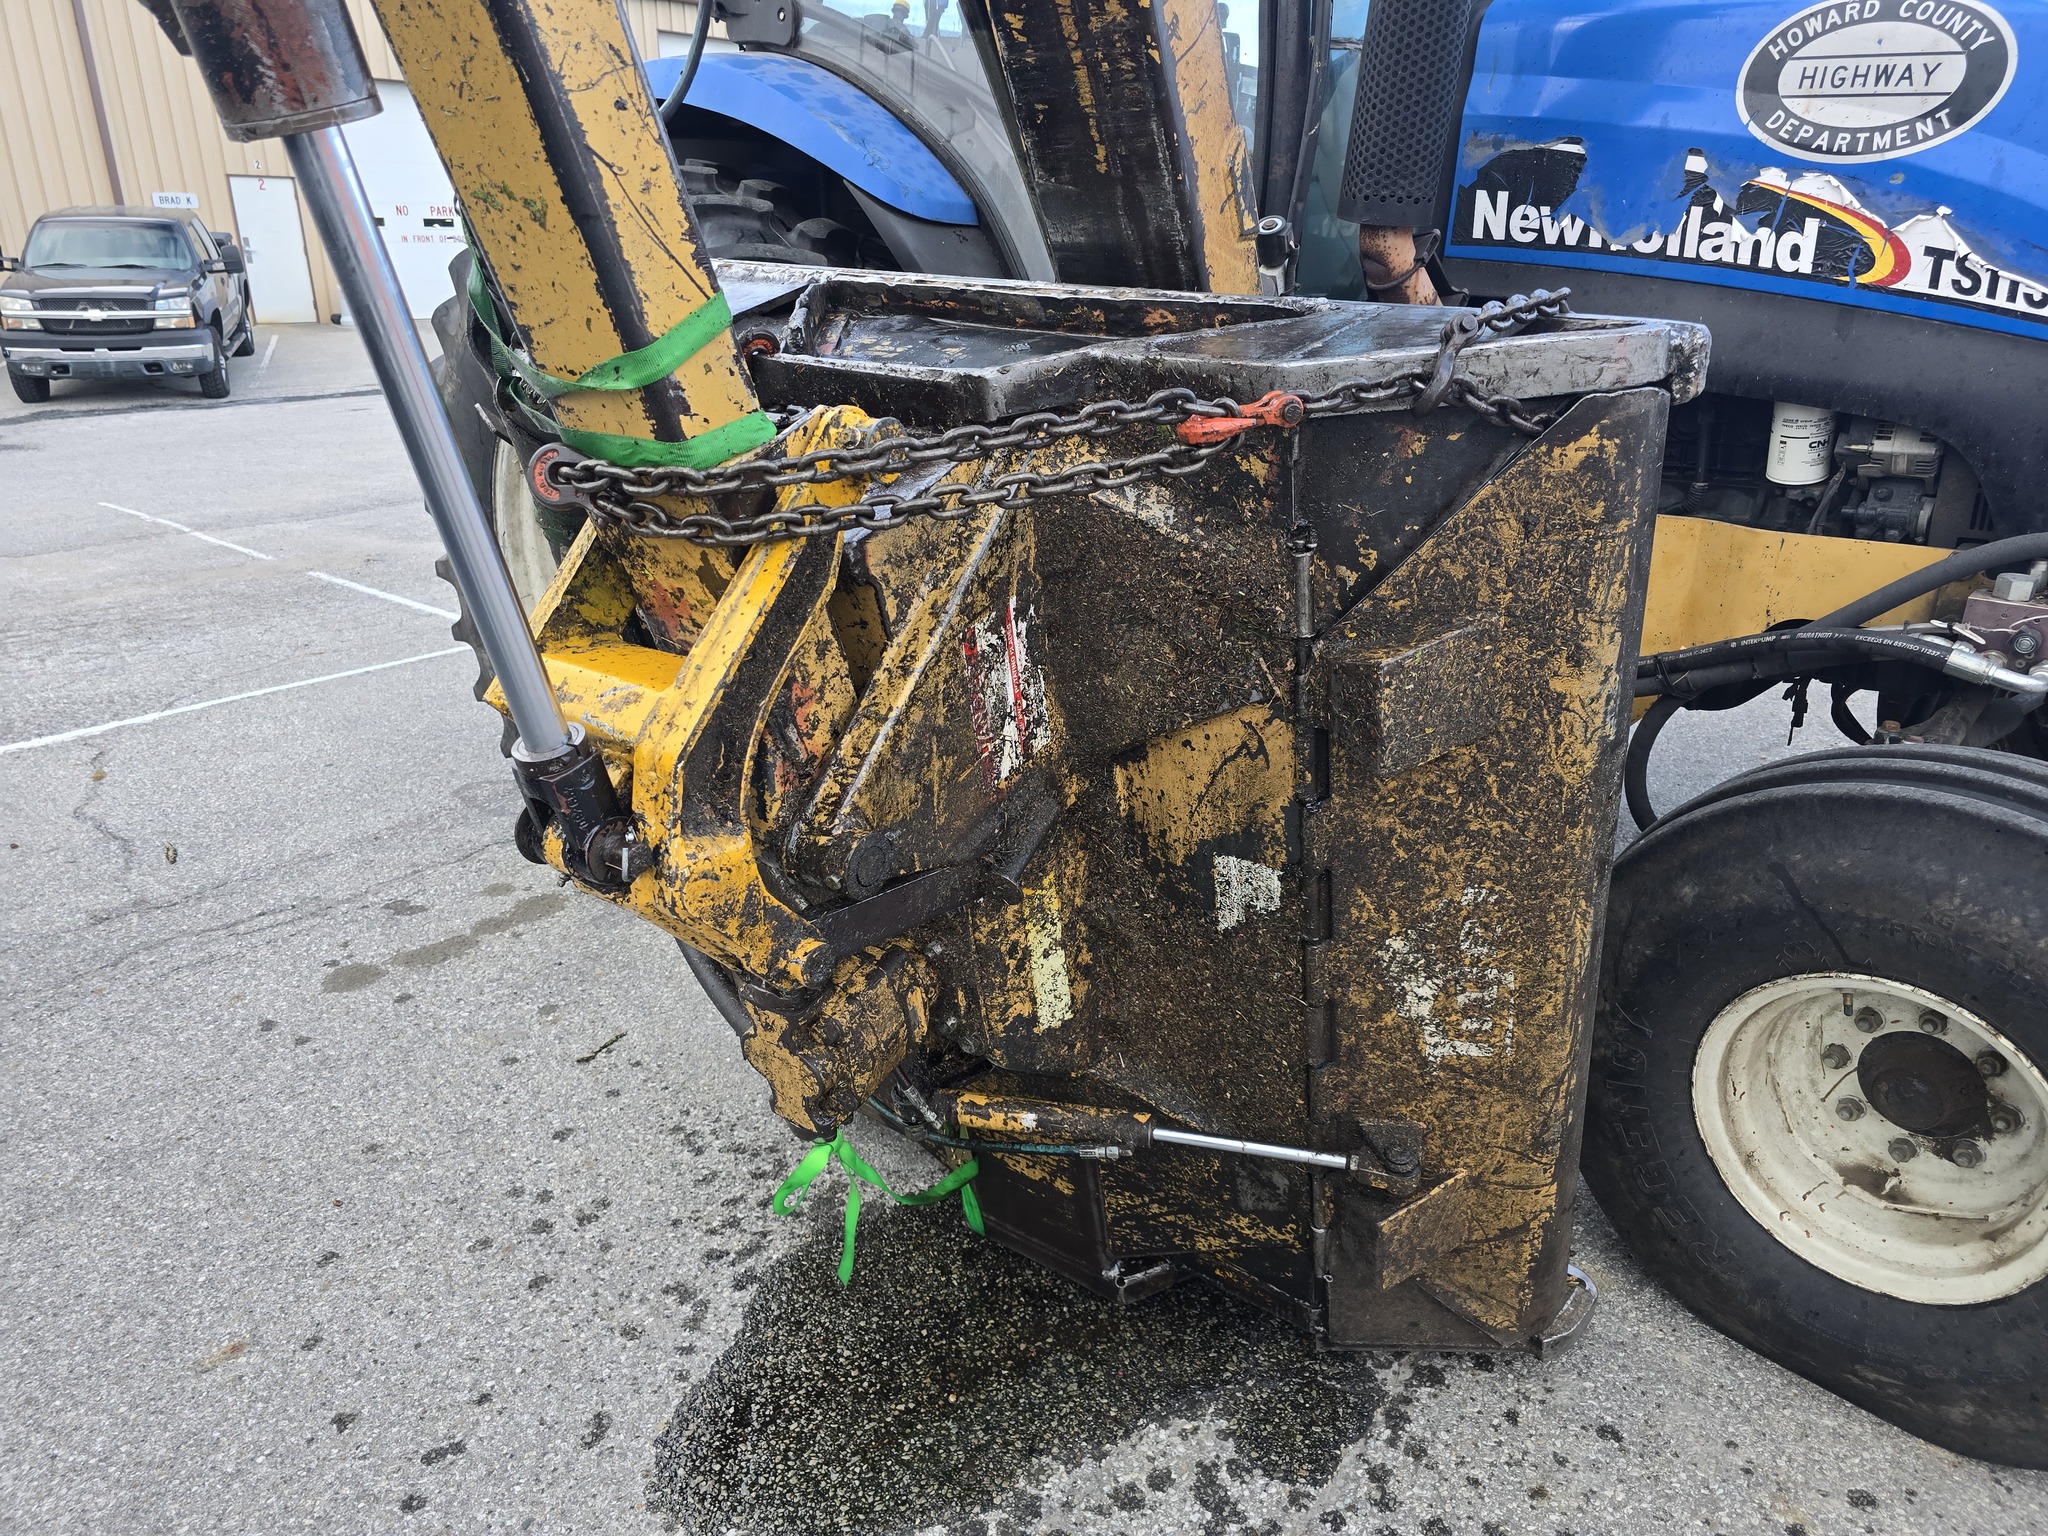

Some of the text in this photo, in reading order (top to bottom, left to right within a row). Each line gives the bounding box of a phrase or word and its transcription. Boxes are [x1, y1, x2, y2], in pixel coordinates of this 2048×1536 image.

[1768, 0, 1995, 61] HOWARD COUNTY
[1798, 62, 1943, 90] HIGHWAY
[1765, 108, 1951, 153] DEPARTMENT
[255, 160, 261, 170] 2
[258, 178, 266, 190] 2
[159, 196, 192, 205] BRAD K
[395, 205, 459, 217] NO PARK
[401, 235, 408, 243] IN
[413, 235, 434, 243] FRONT
[1588, 206, 1821, 274] lland
[1808, 435, 1831, 449] CNH
[1741, 635, 1776, 646] INTERPUMP
[1855, 635, 1883, 644] EXCEEDS
[1893, 641, 1920, 651] 857/ISO
[1920, 647, 1940, 657] 11237
